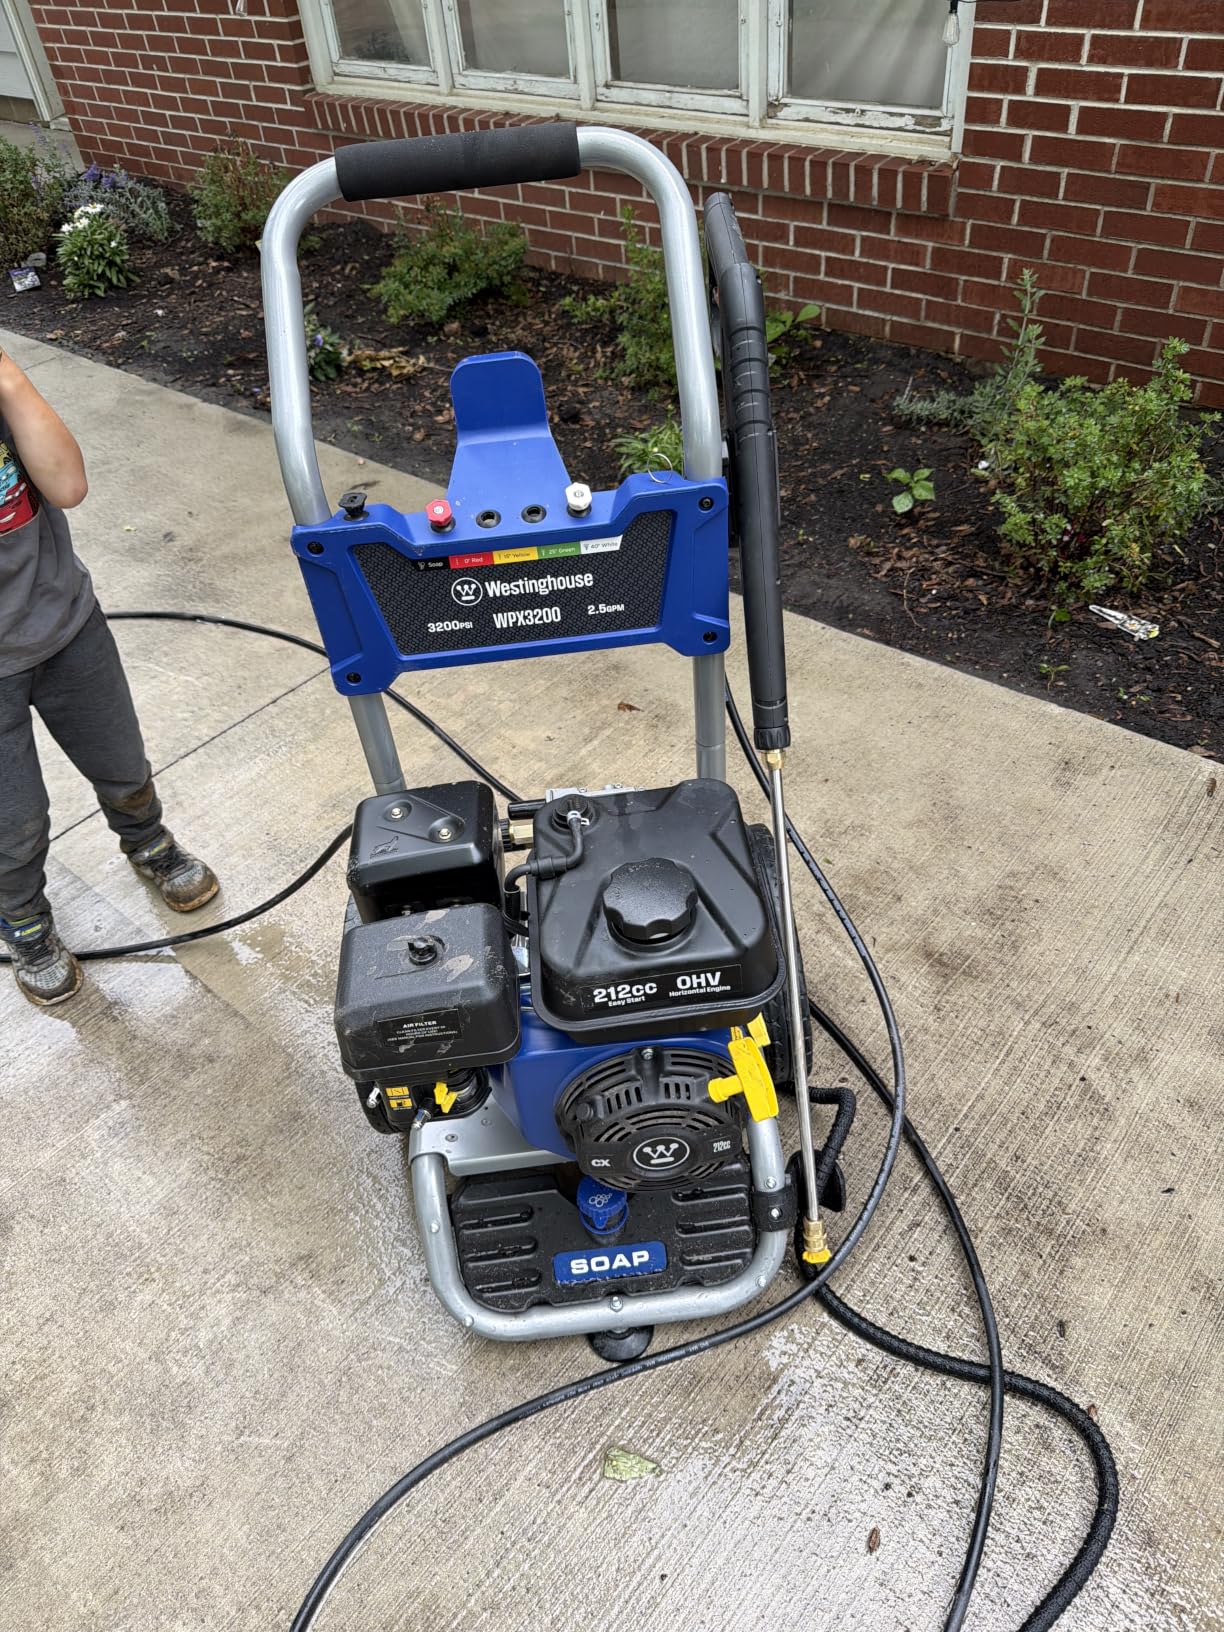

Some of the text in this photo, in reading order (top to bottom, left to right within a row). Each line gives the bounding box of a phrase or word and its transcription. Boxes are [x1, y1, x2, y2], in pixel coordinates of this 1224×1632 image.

[601, 541, 619, 549] White
[485, 573, 594, 598] Westinghouse
[587, 603, 625, 615] 2.5GPM
[493, 606, 562, 629] WPX3200
[427, 620, 473, 633] 3200PSI
[676, 971, 721, 990] OHV
[593, 982, 658, 1003] 212cc
[669, 985, 731, 997] Horizontal Engine
[627, 996, 646, 1004] Start
[712, 1140, 732, 1153] 212cc
[590, 1158, 612, 1167] CX
[570, 1250, 650, 1275] SOAP
